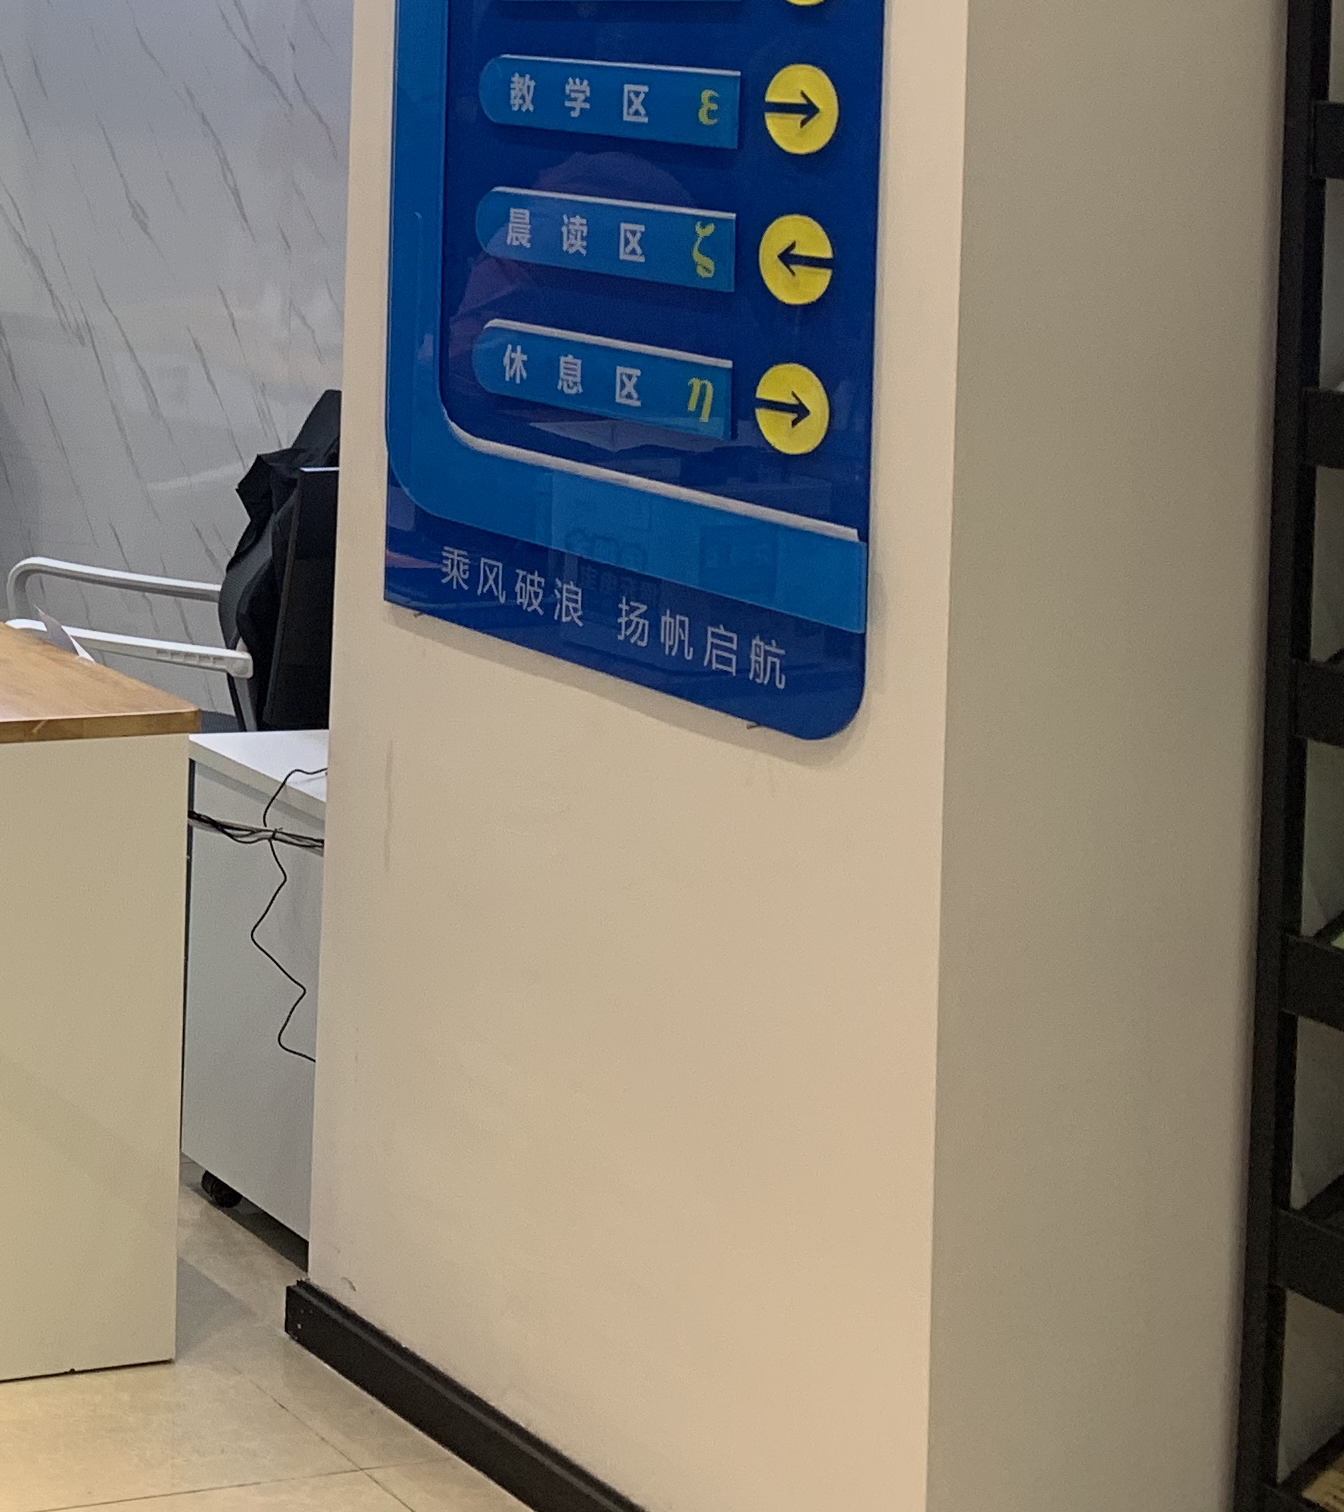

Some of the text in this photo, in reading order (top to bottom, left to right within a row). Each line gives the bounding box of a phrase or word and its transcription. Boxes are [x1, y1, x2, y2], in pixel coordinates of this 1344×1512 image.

[509, 73, 650, 124] 教学区
[505, 208, 647, 263] 晨读区
[502, 344, 643, 407] 休息区
[440, 545, 787, 690] 乘风破浪 扬帆启航
